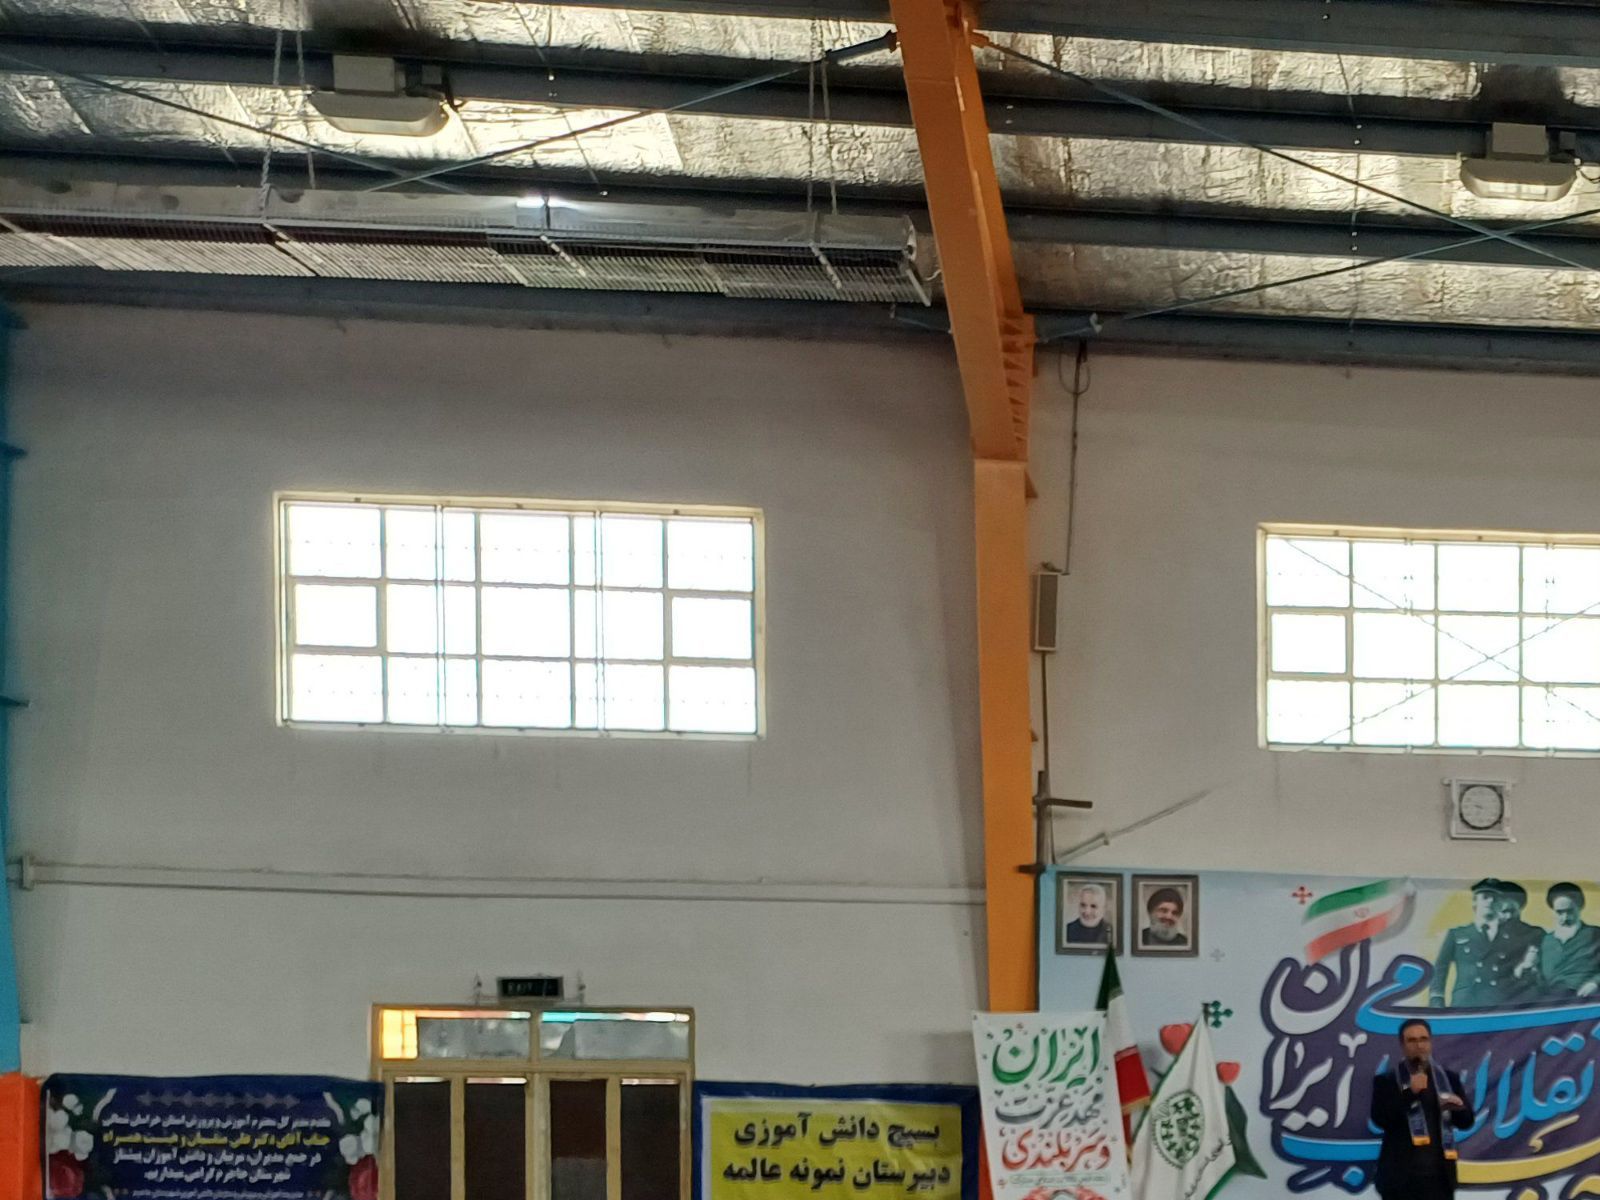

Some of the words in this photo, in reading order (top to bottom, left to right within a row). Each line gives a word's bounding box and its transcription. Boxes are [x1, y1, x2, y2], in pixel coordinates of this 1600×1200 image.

[1268, 942, 1363, 1132] ایران
[991, 1026, 1100, 1089] ایران
[734, 1112, 812, 1147] آموزی
[818, 1115, 880, 1147] دانش
[887, 1121, 940, 1148] بسیج
[722, 1157, 782, 1181] عالمه
[789, 1157, 846, 1191] نمونه
[852, 1157, 951, 1192] دبیرستان
